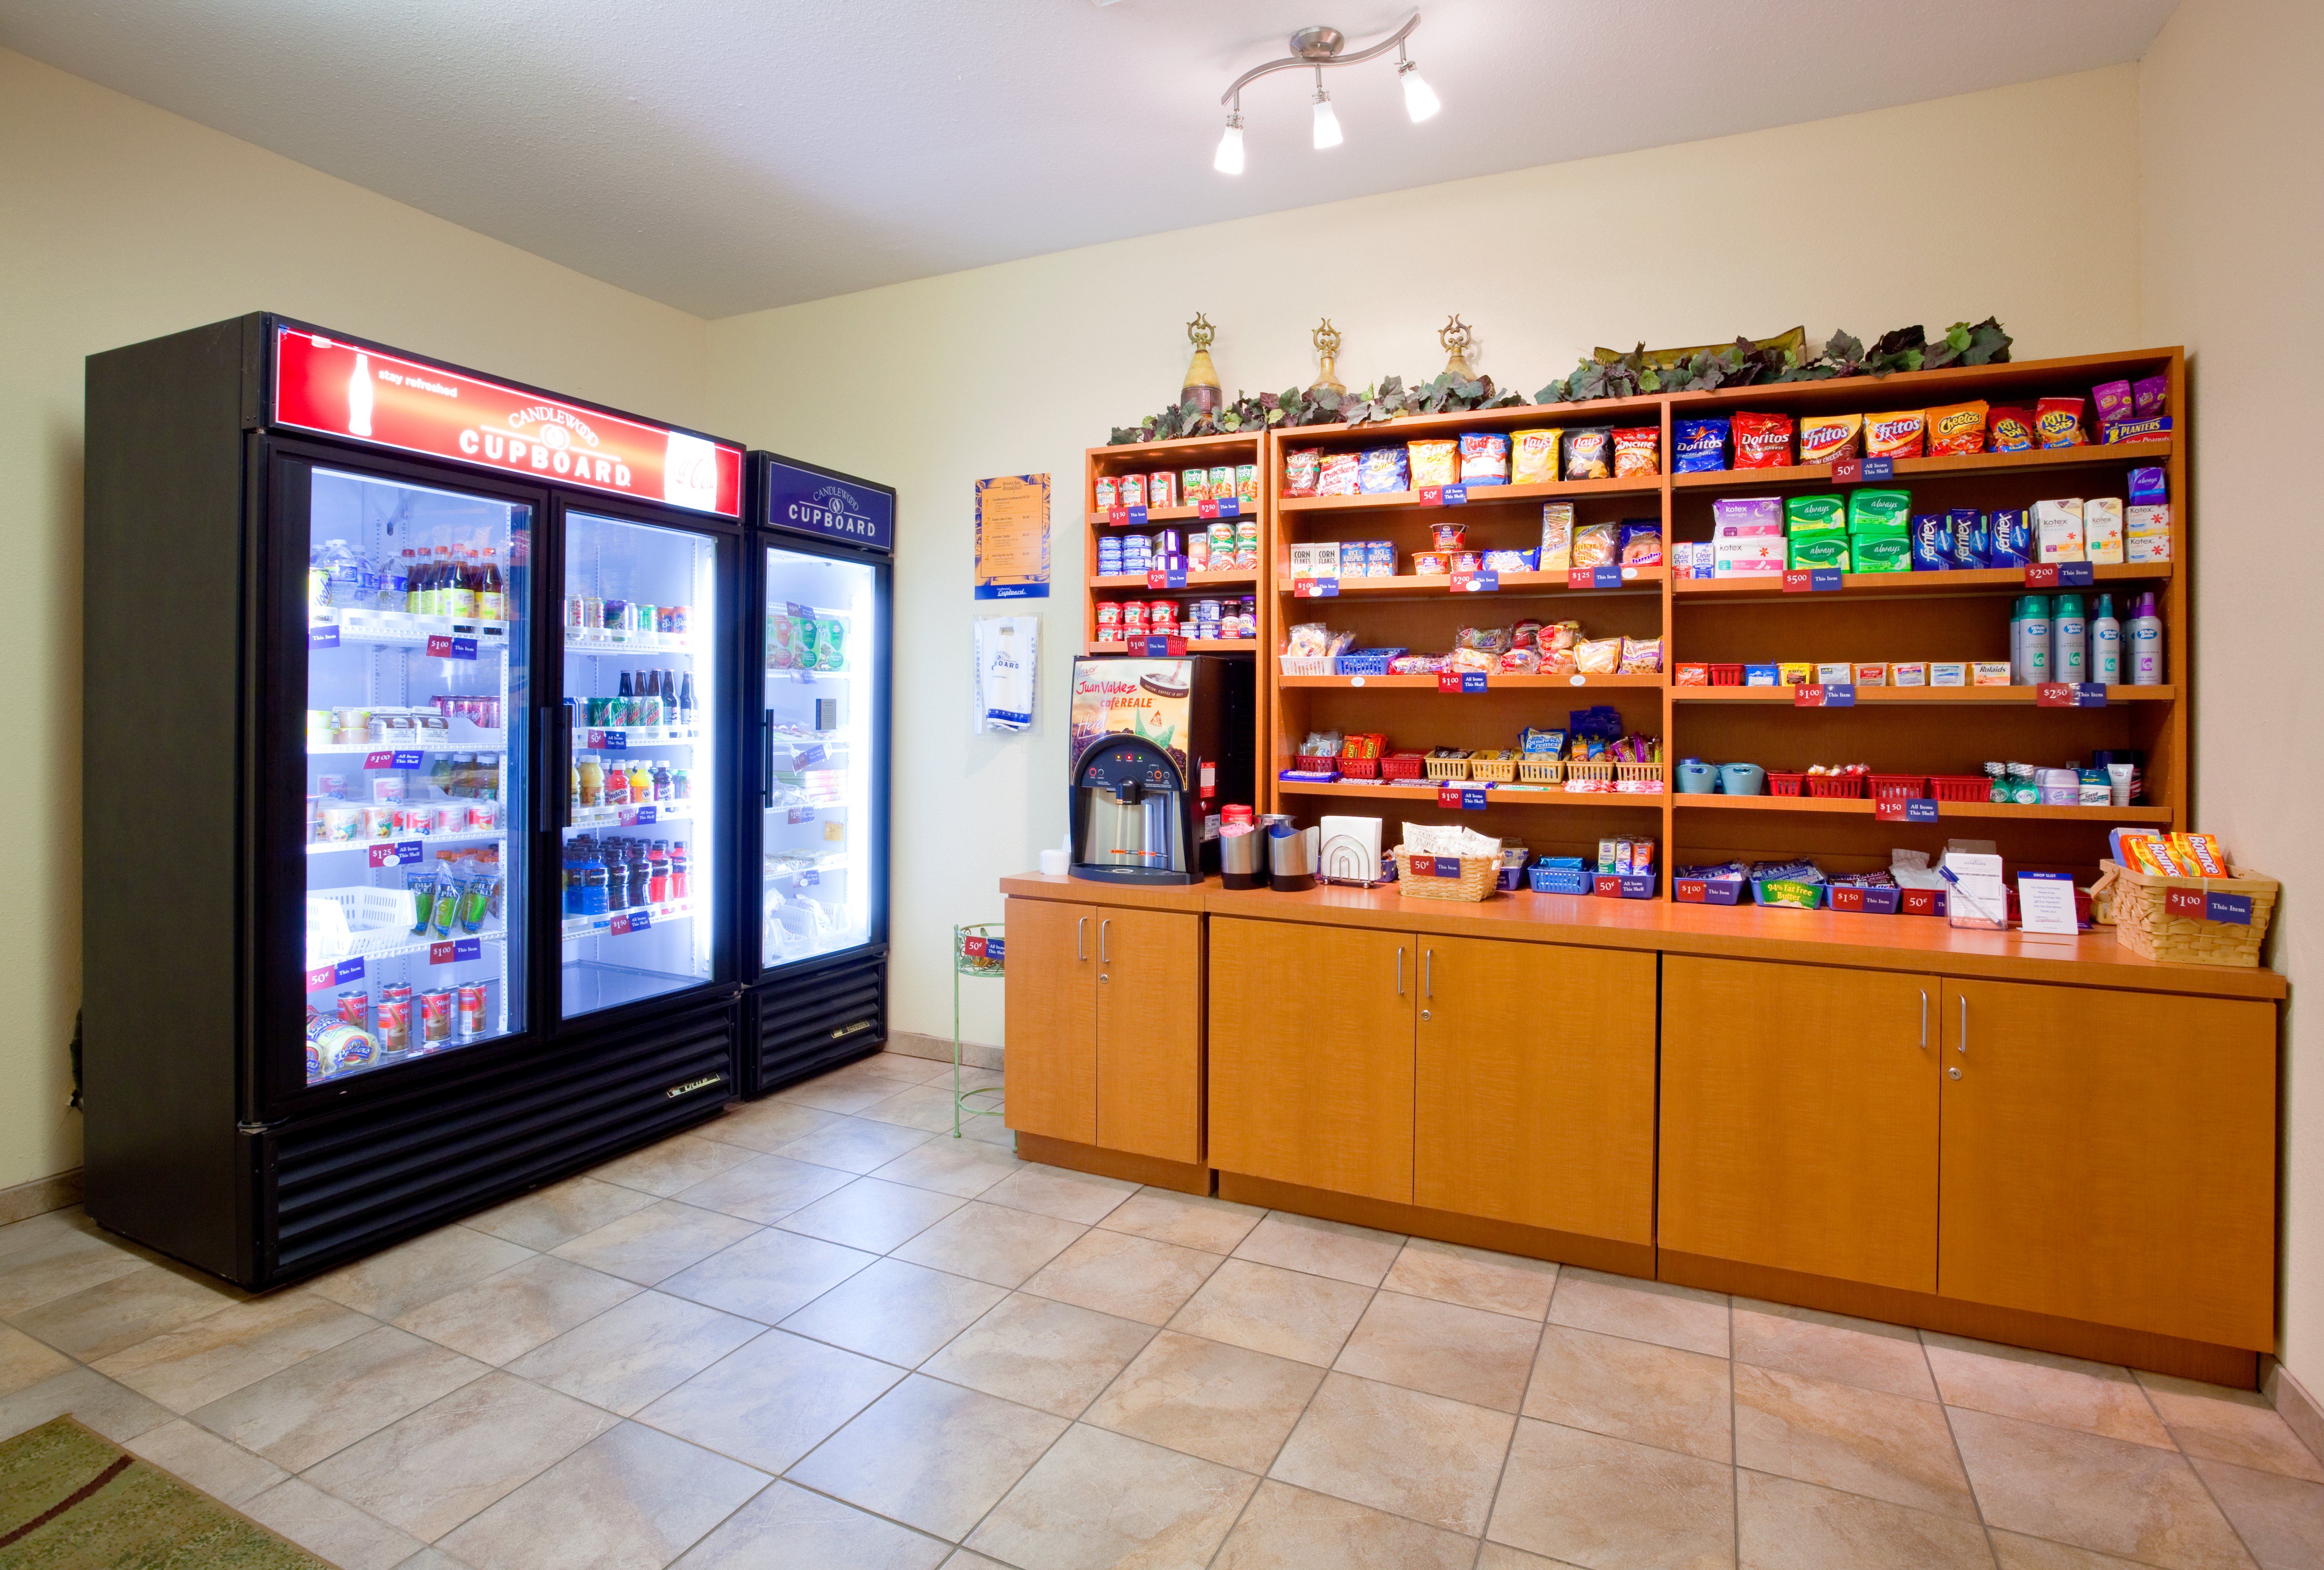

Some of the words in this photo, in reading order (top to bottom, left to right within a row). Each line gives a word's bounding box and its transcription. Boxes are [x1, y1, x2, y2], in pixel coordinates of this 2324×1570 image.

[378, 369, 402, 385] stay
[405, 378, 457, 397] refreshed
[1939, 413, 1981, 433] Cheetos
[2043, 413, 2067, 426] RITZ
[508, 406, 599, 447] CANDLEWOOD
[1874, 418, 1920, 442] Fritos
[2045, 420, 2074, 433] bits
[2121, 420, 2160, 436] PLANTERS
[1465, 436, 1504, 451] Ruffles
[1525, 436, 1551, 449] Lay's
[1574, 435, 1602, 449] Lay's
[1742, 433, 1790, 445] Doritos
[1804, 425, 1848, 449] Fritos
[1420, 443, 1451, 458] Sun
[1677, 439, 1723, 451] Doritos
[1890, 445, 1913, 456] ORIGINAL
[459, 430, 629, 487] CUPBOARD
[1369, 450, 1397, 462] Sun
[1426, 451, 1447, 463] Chips
[1823, 451, 1843, 463] CHEESE
[1324, 465, 1356, 478] Cracker
[1323, 478, 1342, 487] Jack
[813, 486, 859, 511] CANDLEWOOD
[1871, 499, 1898, 508] always
[1804, 505, 1829, 514] always
[789, 504, 875, 537] CUPBOARD
[1576, 525, 1598, 539] Duchess
[1996, 513, 2012, 553] femtex
[1575, 542, 1602, 552] HONEY
[1920, 519, 1936, 562] femtex
[1955, 519, 1971, 562] femtex
[1810, 546, 1835, 555] always
[1874, 545, 1900, 553] always
[1579, 553, 1597, 562] BUN
[1632, 552, 1661, 564] Jumbo
[998, 588, 1025, 597] Cupboard
[1077, 664, 1098, 679] Savor
[1076, 681, 1099, 694] Juan
[1101, 681, 1137, 694] Valdez
[1077, 713, 1108, 737] Here!
[608, 789, 628, 800] Welch's
[2146, 843, 2182, 877] Bounce
[2187, 836, 2218, 874] Bounce
[1769, 868, 1785, 877] ACT
[1778, 892, 1801, 901] Butter
[1796, 888, 1812, 896] Free
